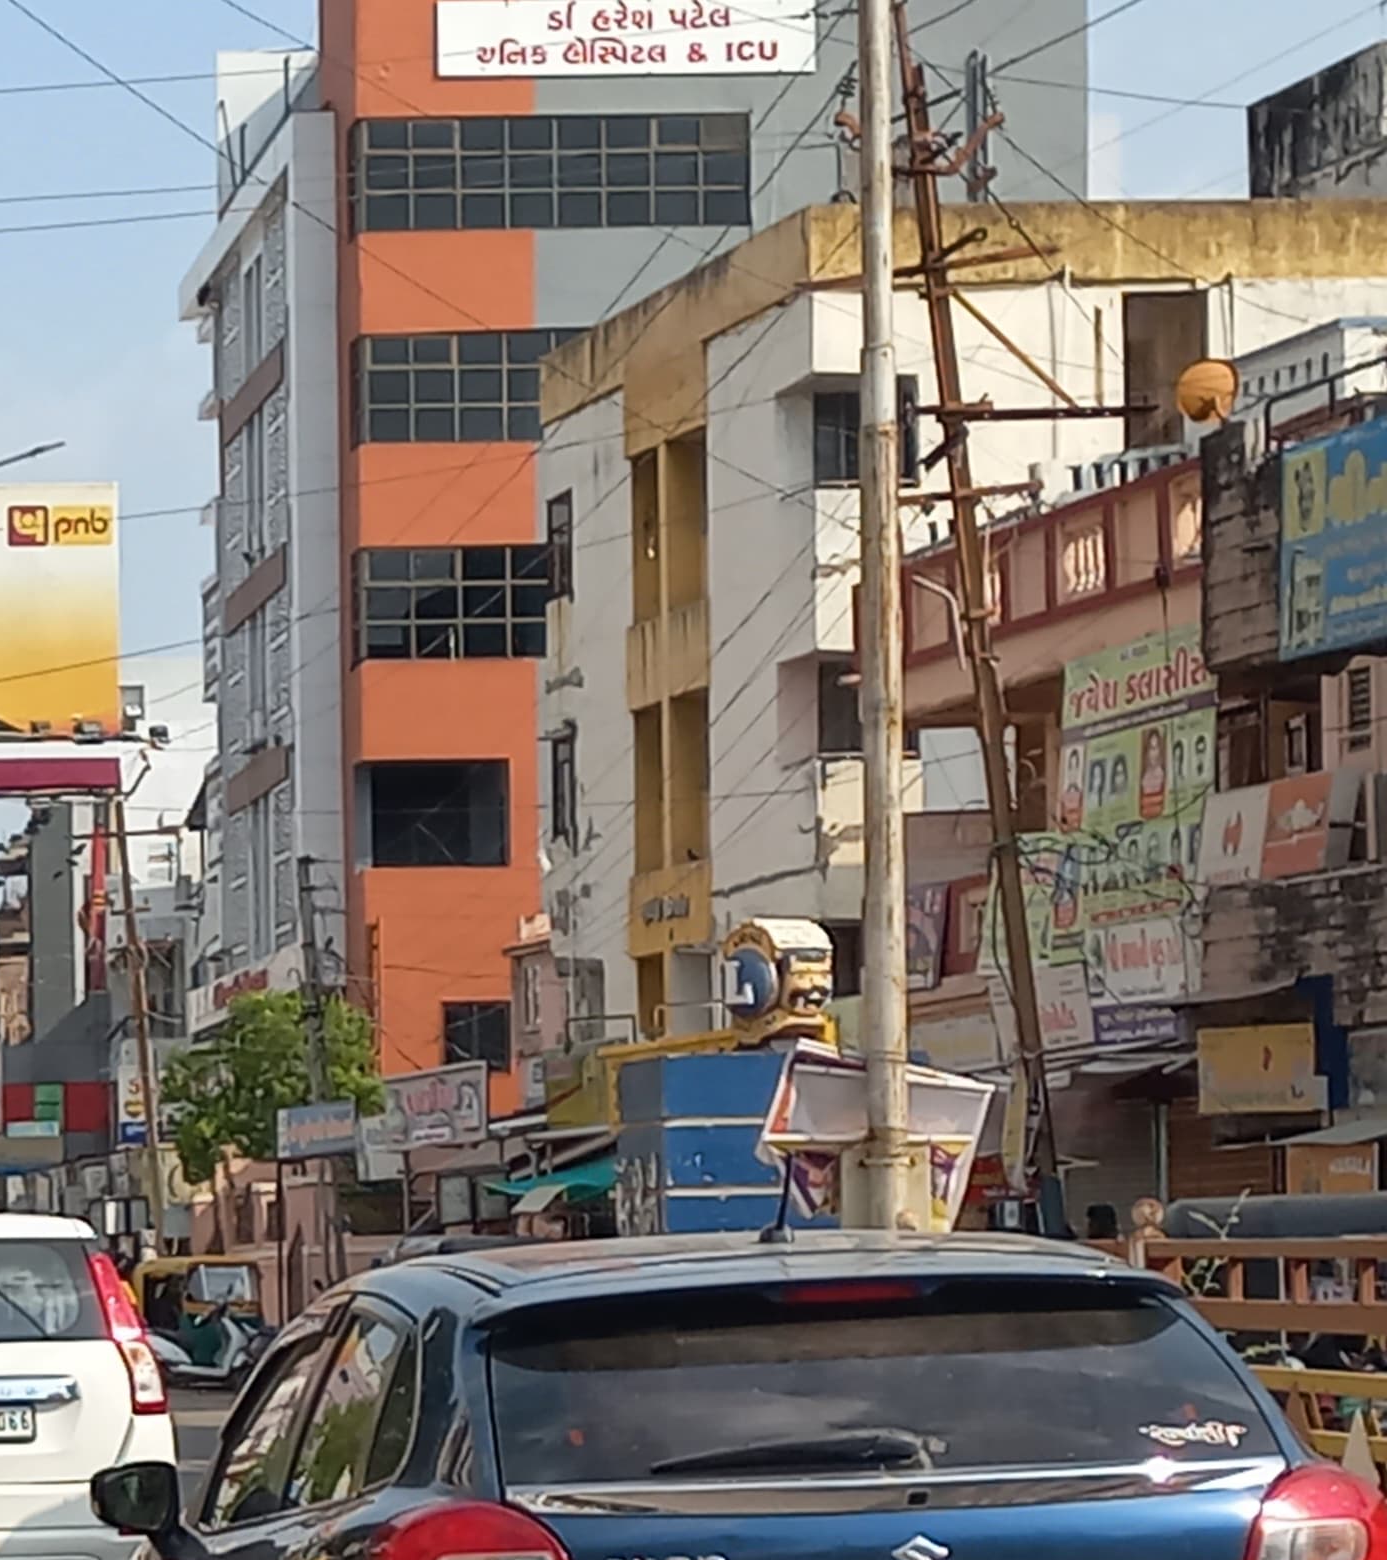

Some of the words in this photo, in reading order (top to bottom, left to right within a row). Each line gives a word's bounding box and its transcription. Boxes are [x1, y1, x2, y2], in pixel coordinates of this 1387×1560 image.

[688, 42, 707, 62] &
[725, 40, 779, 61] ICU
[54, 508, 109, 543] pnb
